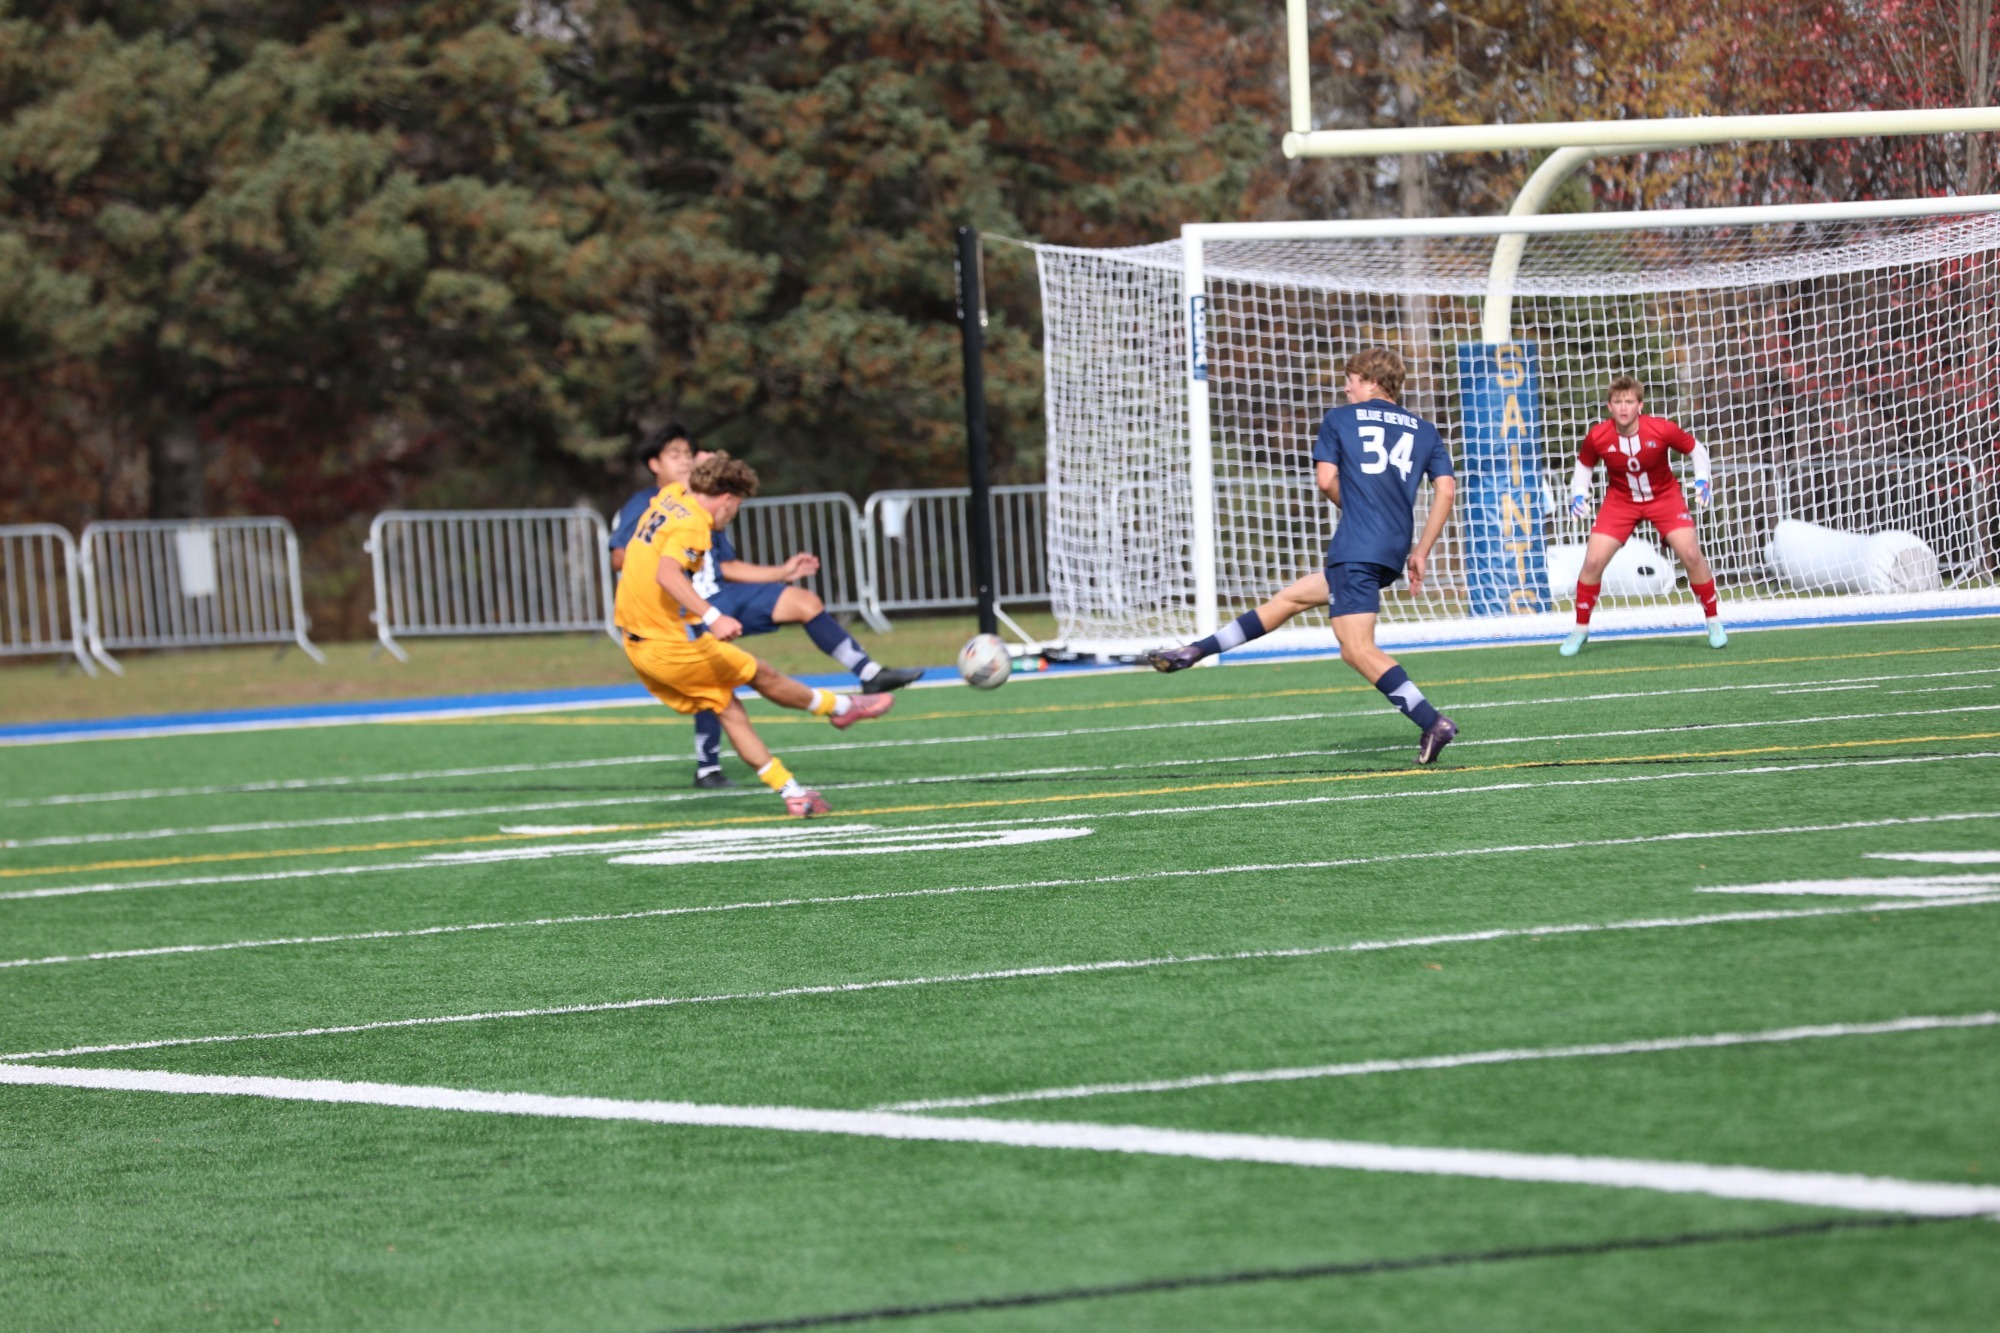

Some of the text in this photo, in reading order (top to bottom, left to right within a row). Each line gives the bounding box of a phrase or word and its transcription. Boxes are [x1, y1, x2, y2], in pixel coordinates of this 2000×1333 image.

[1355, 409, 1418, 430] BLUE DEVILS
[1358, 426, 1415, 482] 34
[1495, 345, 1538, 614] SAINTS
